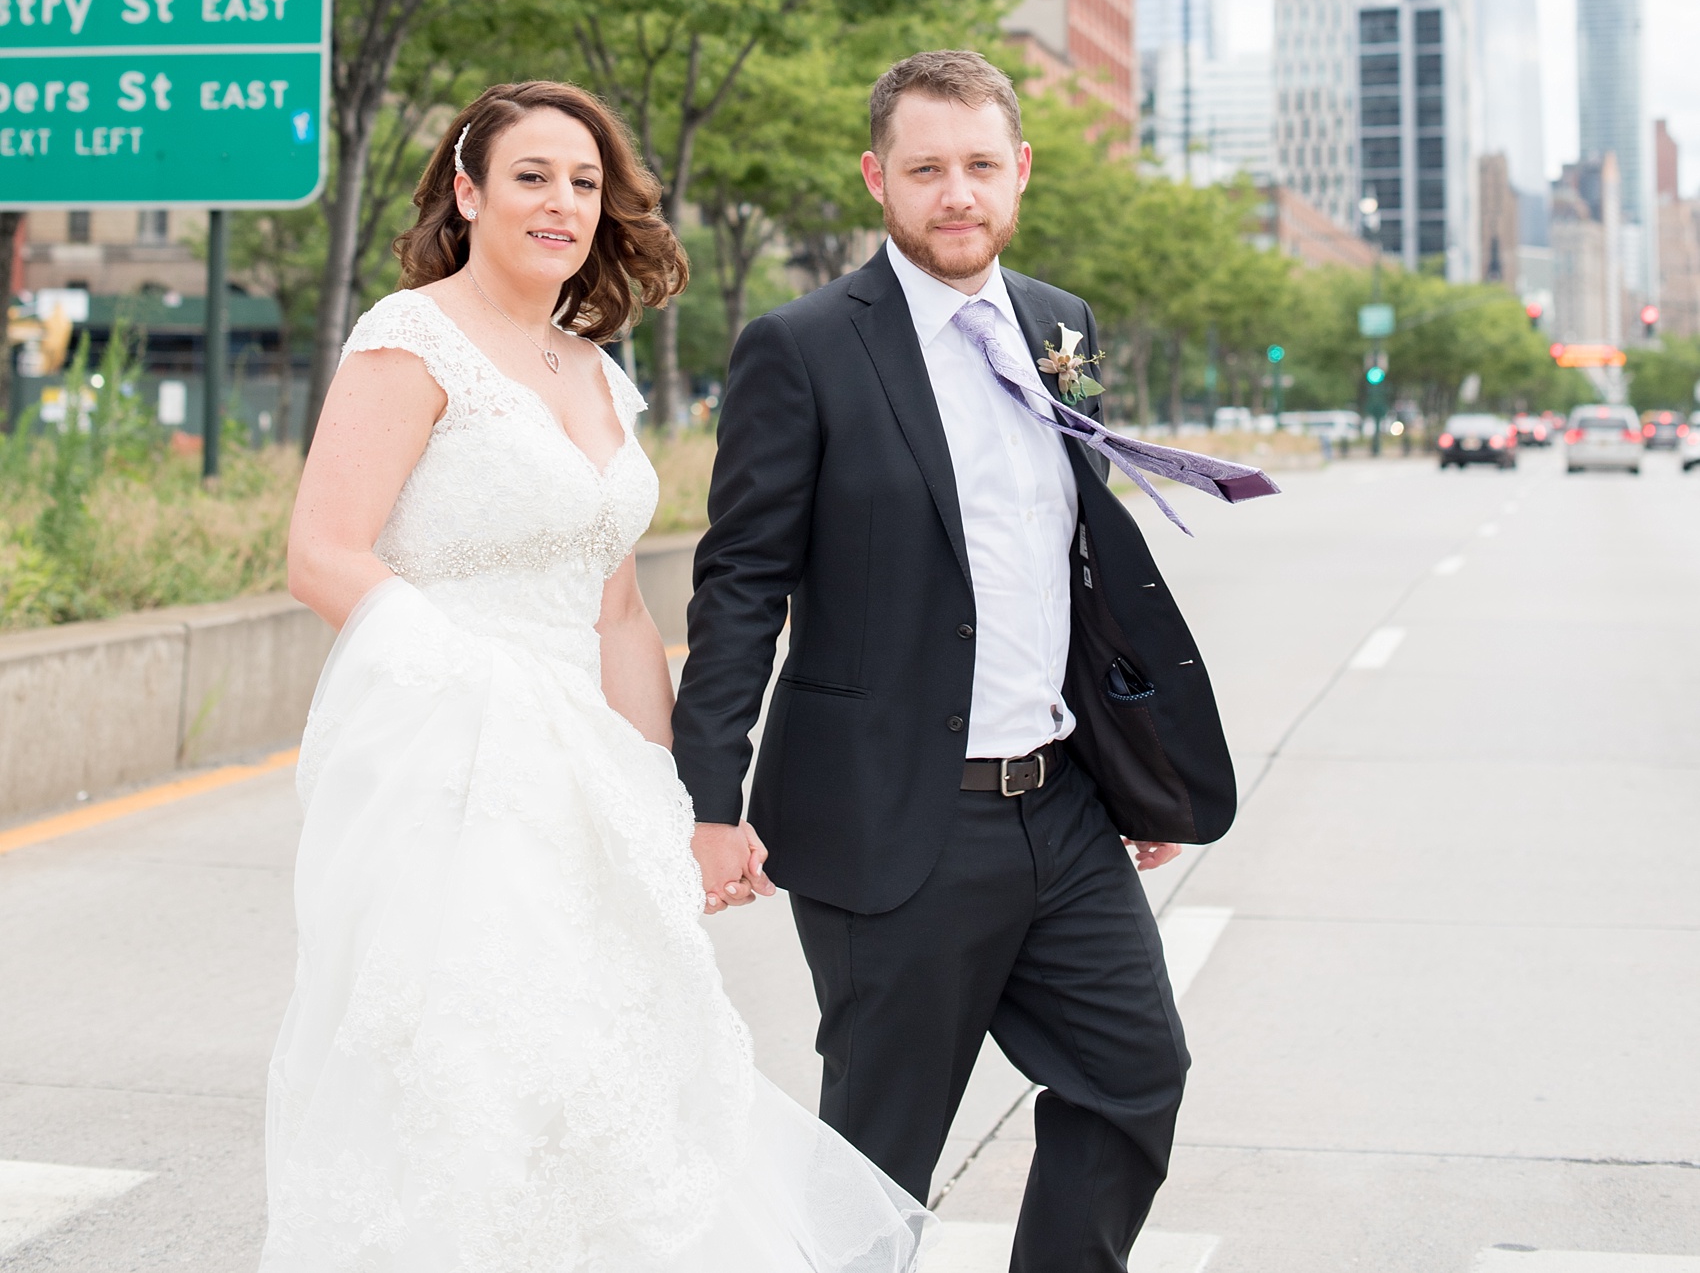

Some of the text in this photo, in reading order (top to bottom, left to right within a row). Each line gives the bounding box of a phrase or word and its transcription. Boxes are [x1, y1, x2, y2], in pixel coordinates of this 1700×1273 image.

[117, 70, 172, 112] St
[200, 80, 289, 110] EAST
[0, 126, 143, 156] EXT LEFT
